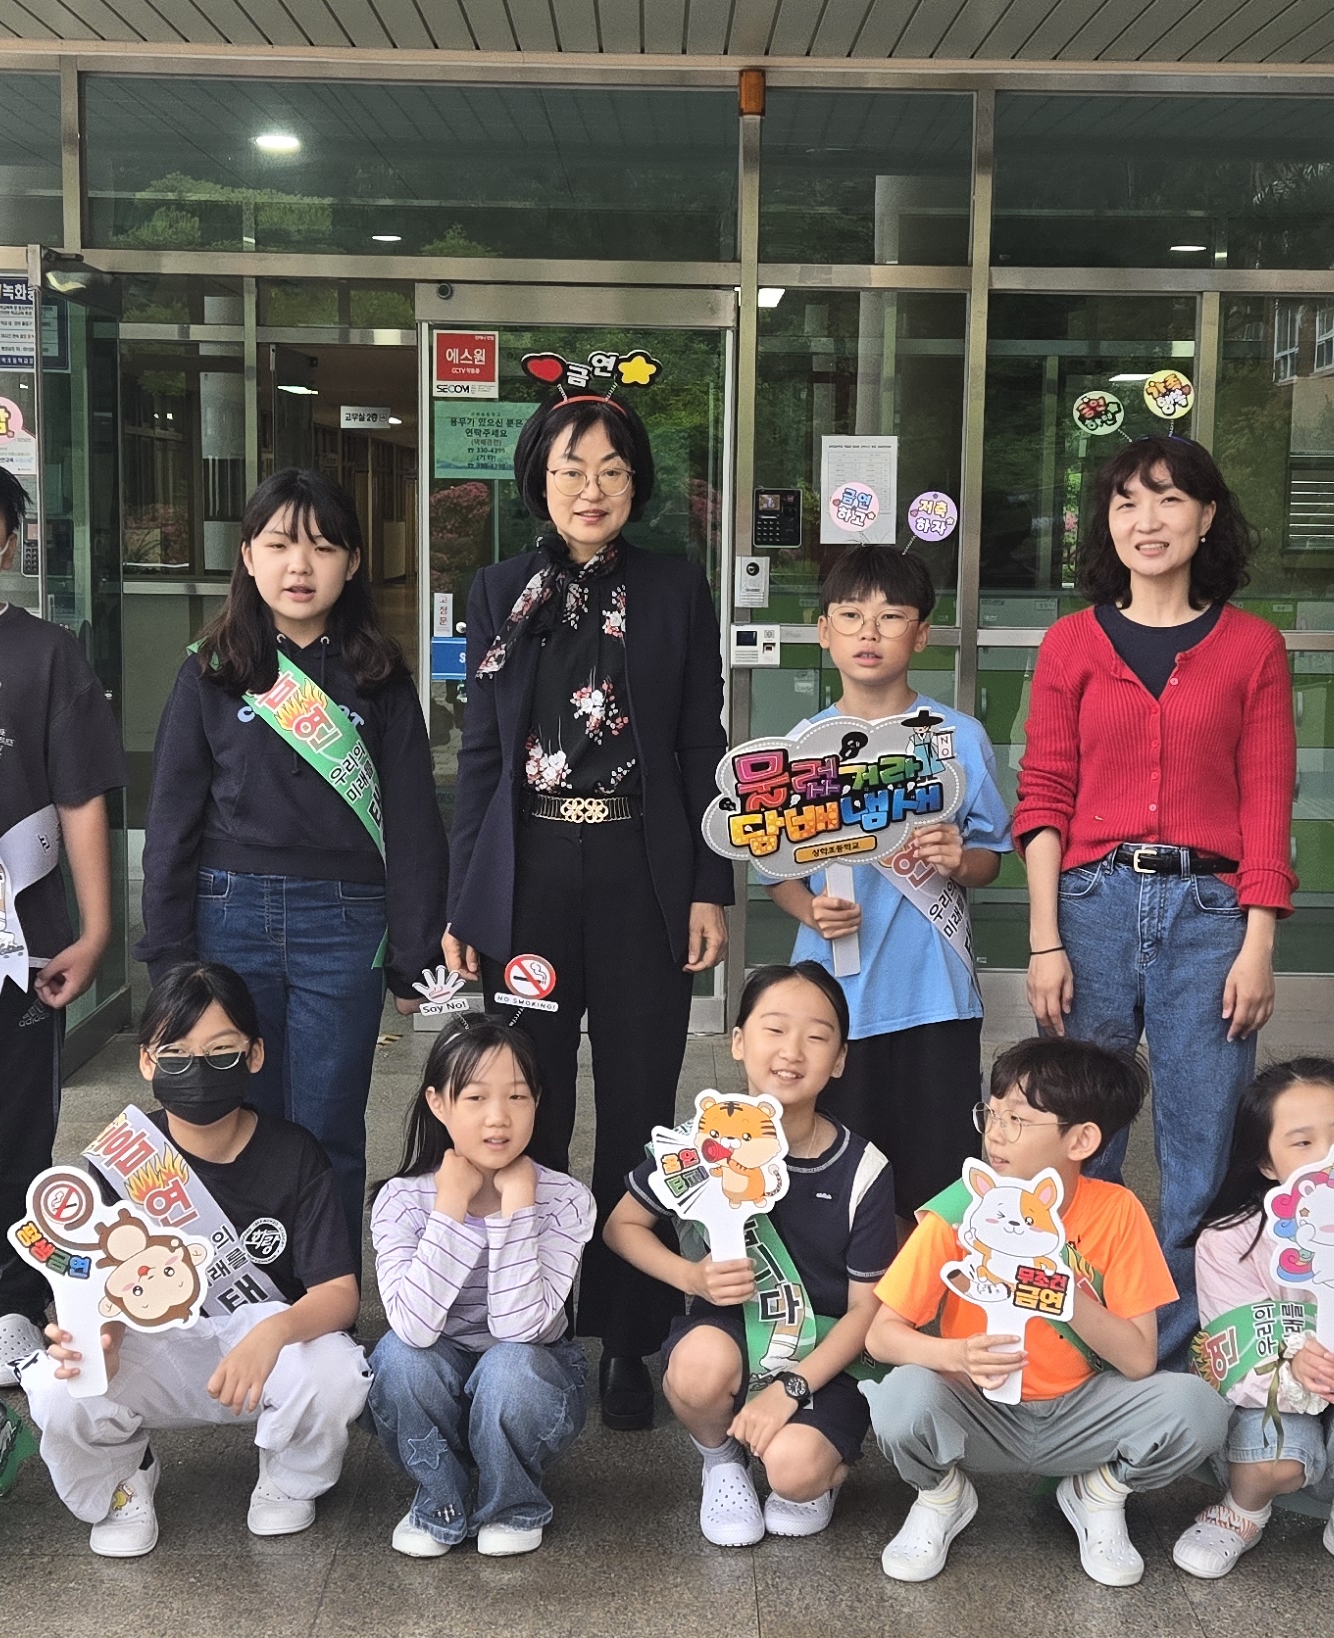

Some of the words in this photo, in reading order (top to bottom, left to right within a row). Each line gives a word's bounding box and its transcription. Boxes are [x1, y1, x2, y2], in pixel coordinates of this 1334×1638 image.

[445, 348, 486, 366] 에스원
[567, 354, 617, 389] 금연
[436, 385, 470, 393] SECOM
[450, 417, 475, 427] 용무가
[478, 417, 503, 428] 있으신
[506, 418, 524, 428] 분은
[465, 428, 508, 438] 연락주세요
[840, 487, 873, 510] 금연
[836, 506, 868, 527] 하고
[915, 517, 947, 535] 하자
[729, 782, 944, 857] 담배냄새
[422, 1002, 444, 1014] Say
[446, 1001, 467, 1011] No!
[496, 995, 510, 1003] NO
[512, 997, 557, 1011] SMOKING!
[1015, 1264, 1071, 1293] 무조건
[1013, 1283, 1066, 1316] 금연
[1251, 1301, 1278, 1358] 우리의
